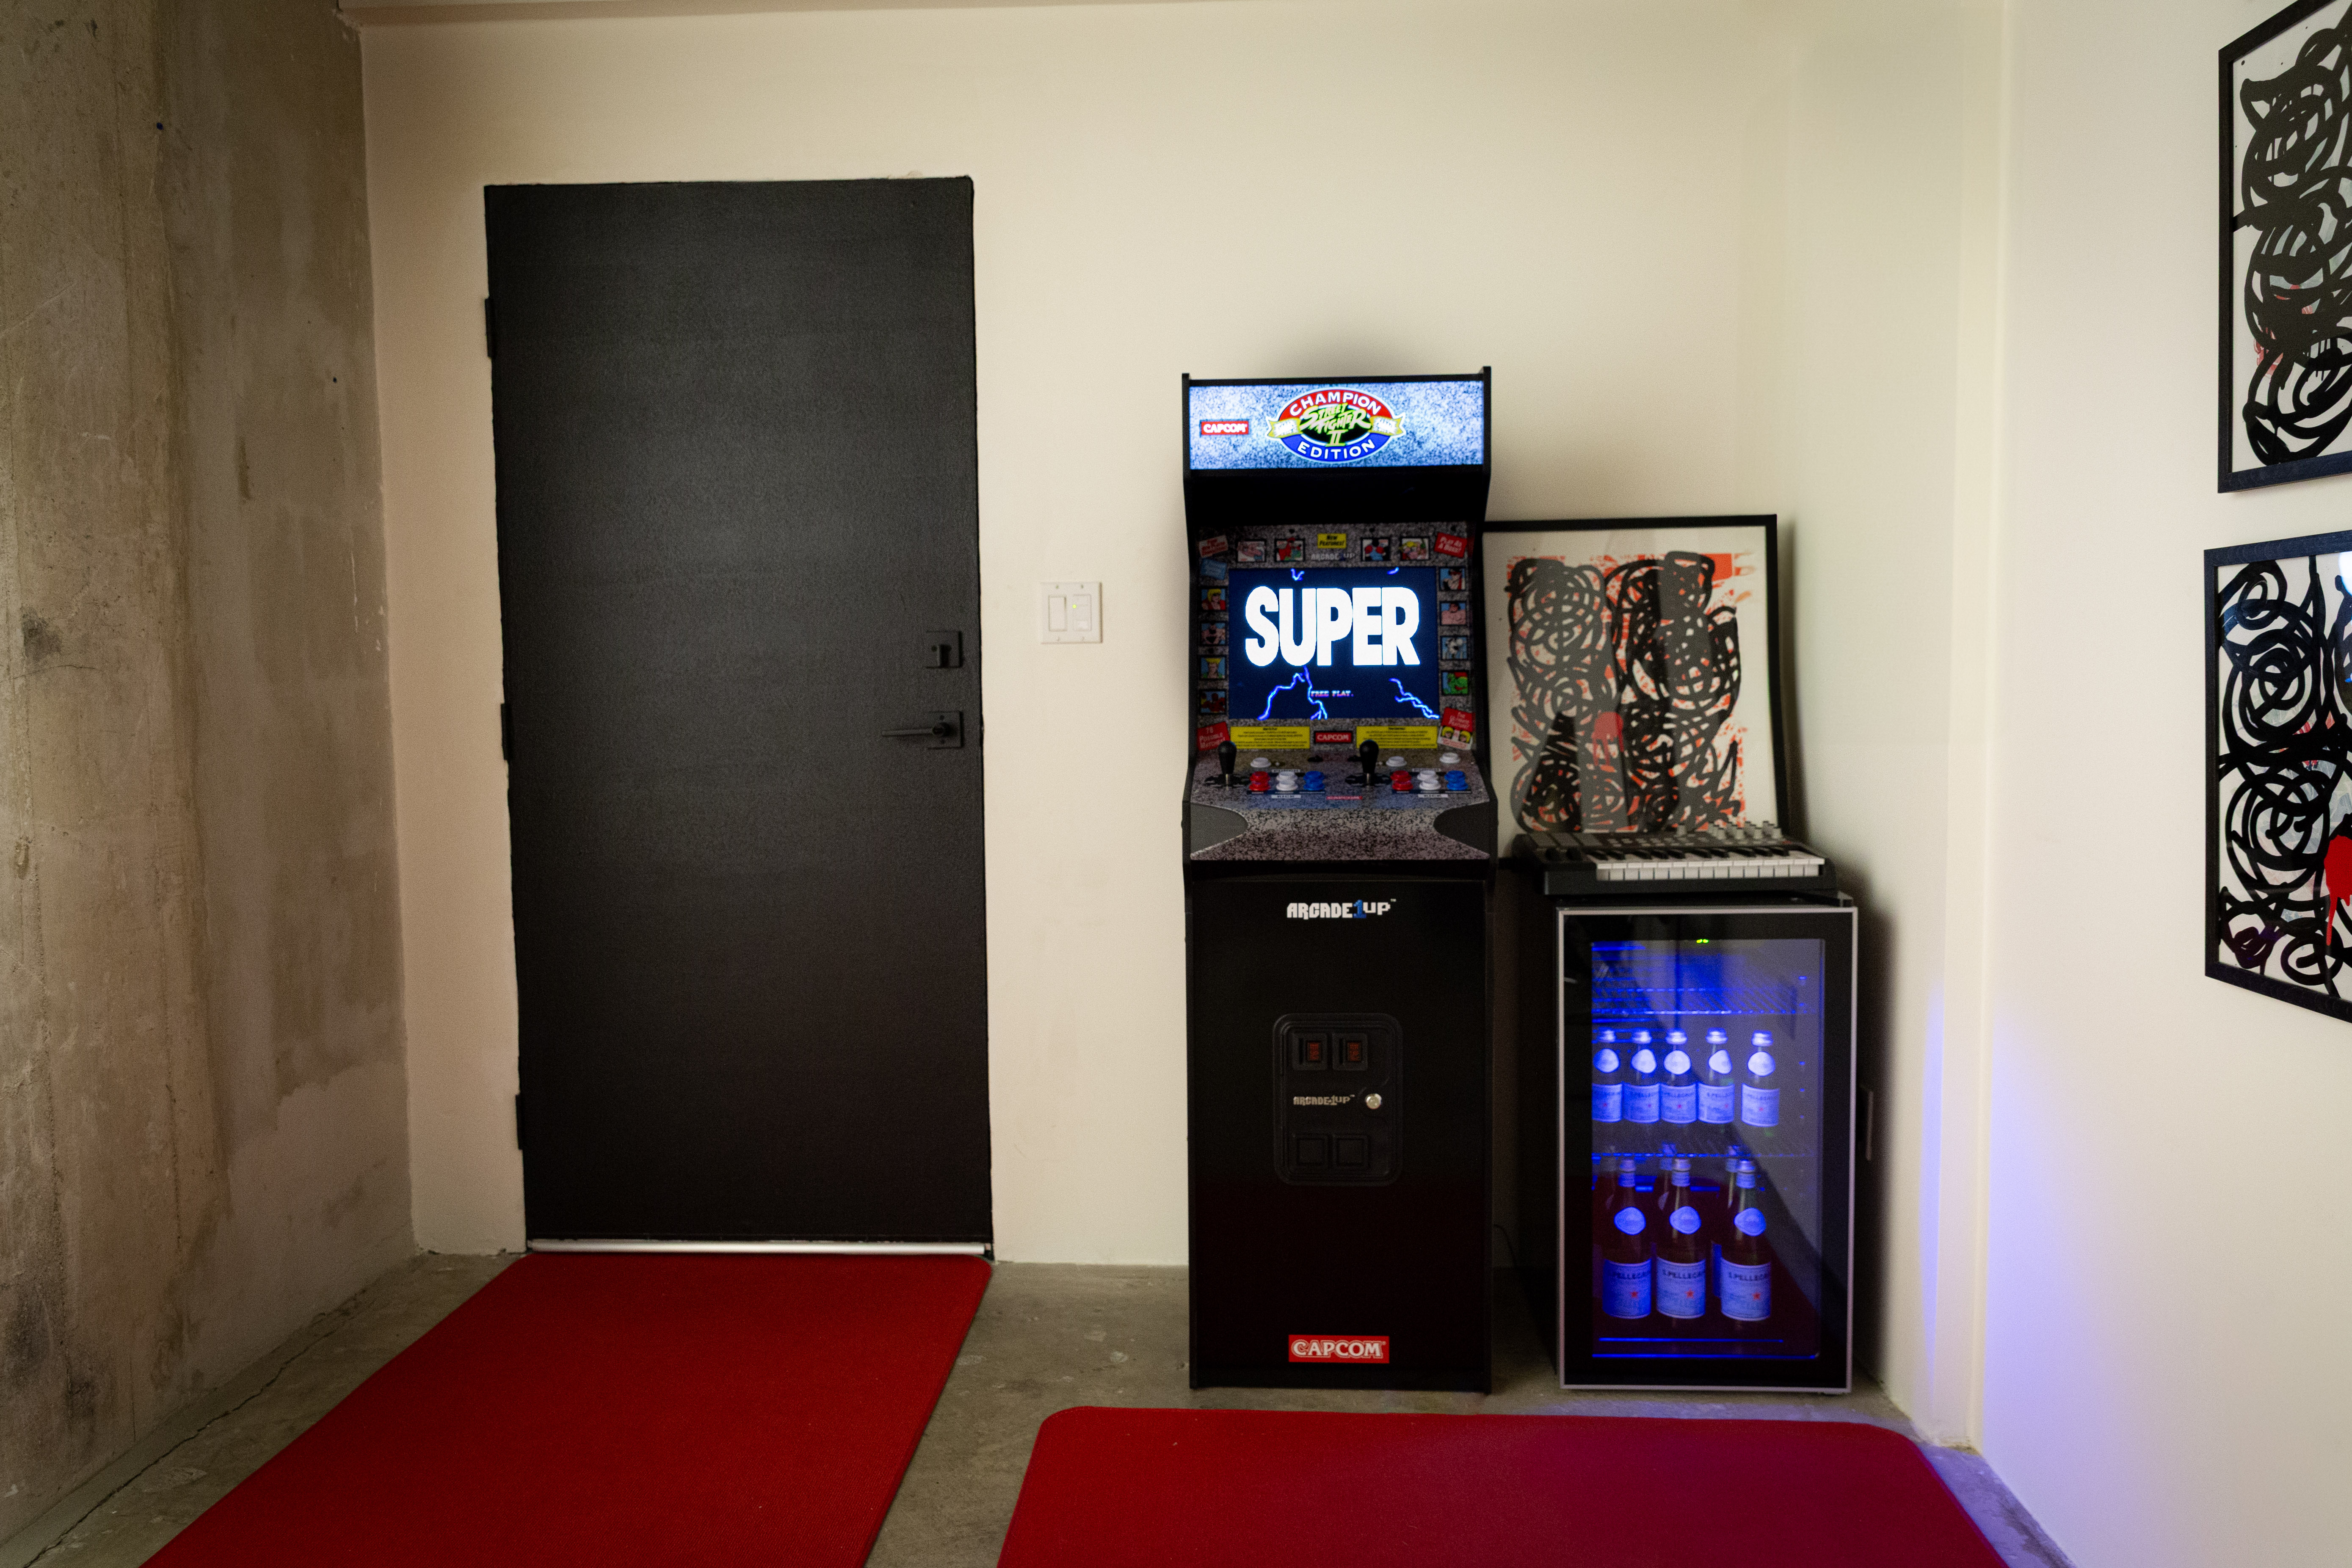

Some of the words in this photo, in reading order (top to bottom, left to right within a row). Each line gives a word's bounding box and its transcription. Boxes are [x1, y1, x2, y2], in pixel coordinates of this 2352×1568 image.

[1290, 391, 1381, 416] CHAMPION
[1299, 402, 1348, 431] STREET
[1306, 408, 1372, 434] FIGHTER
[1203, 423, 1246, 433] CAPCOM
[1325, 429, 1349, 447] II
[1297, 439, 1375, 459] EDITION
[1245, 585, 1421, 667] SUPER
[1291, 1339, 1383, 1359] CAPCOM
